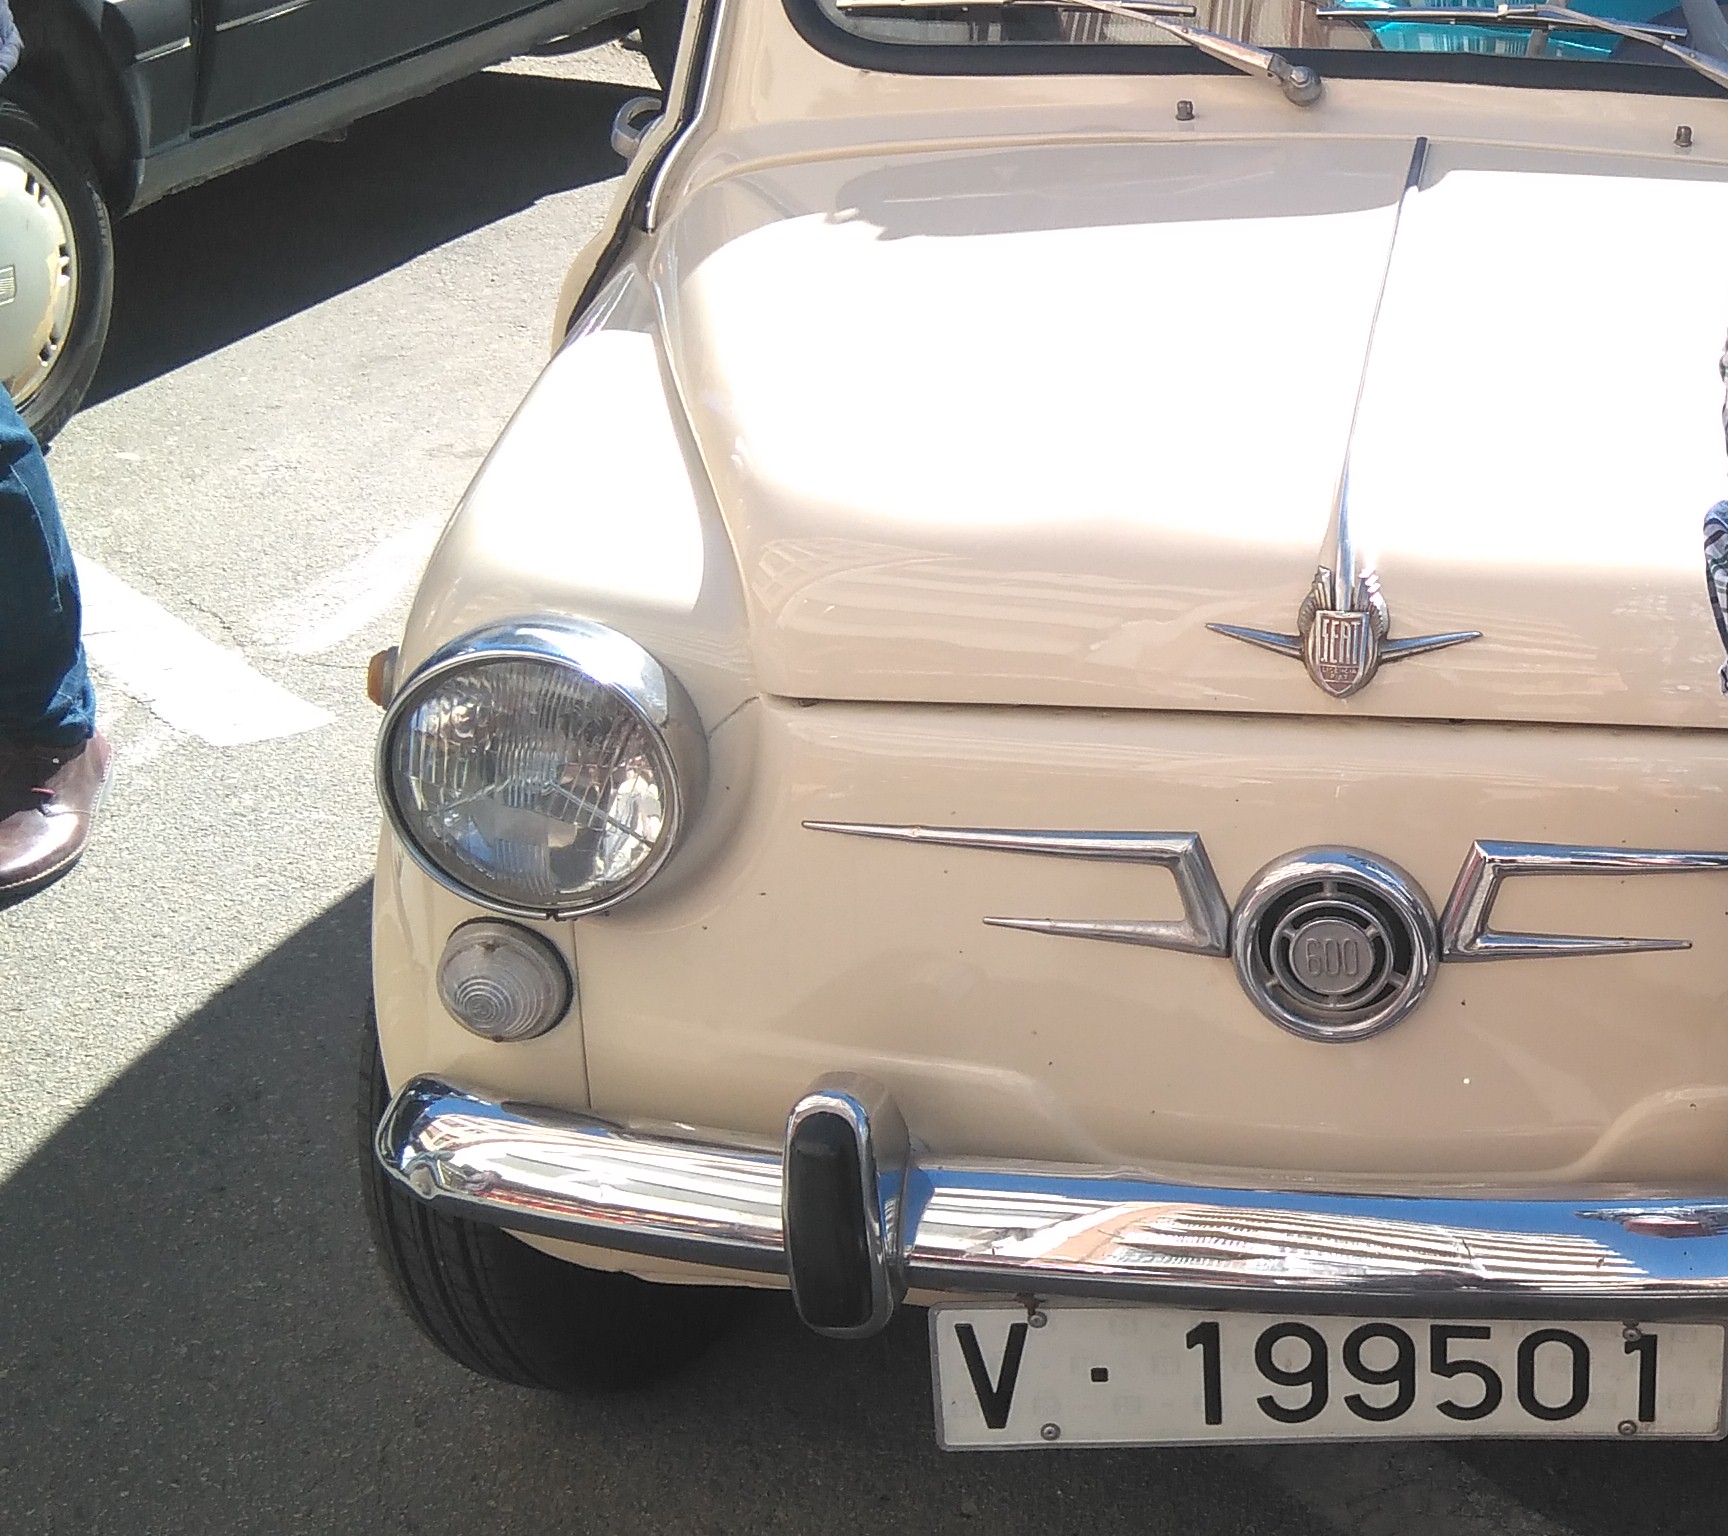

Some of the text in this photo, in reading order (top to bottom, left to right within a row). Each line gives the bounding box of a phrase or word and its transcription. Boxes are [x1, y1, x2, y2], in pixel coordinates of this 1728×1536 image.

[1320, 618, 1361, 665] SEAT
[1306, 938, 1359, 977] 600
[1185, 1320, 1658, 1426] 199501
